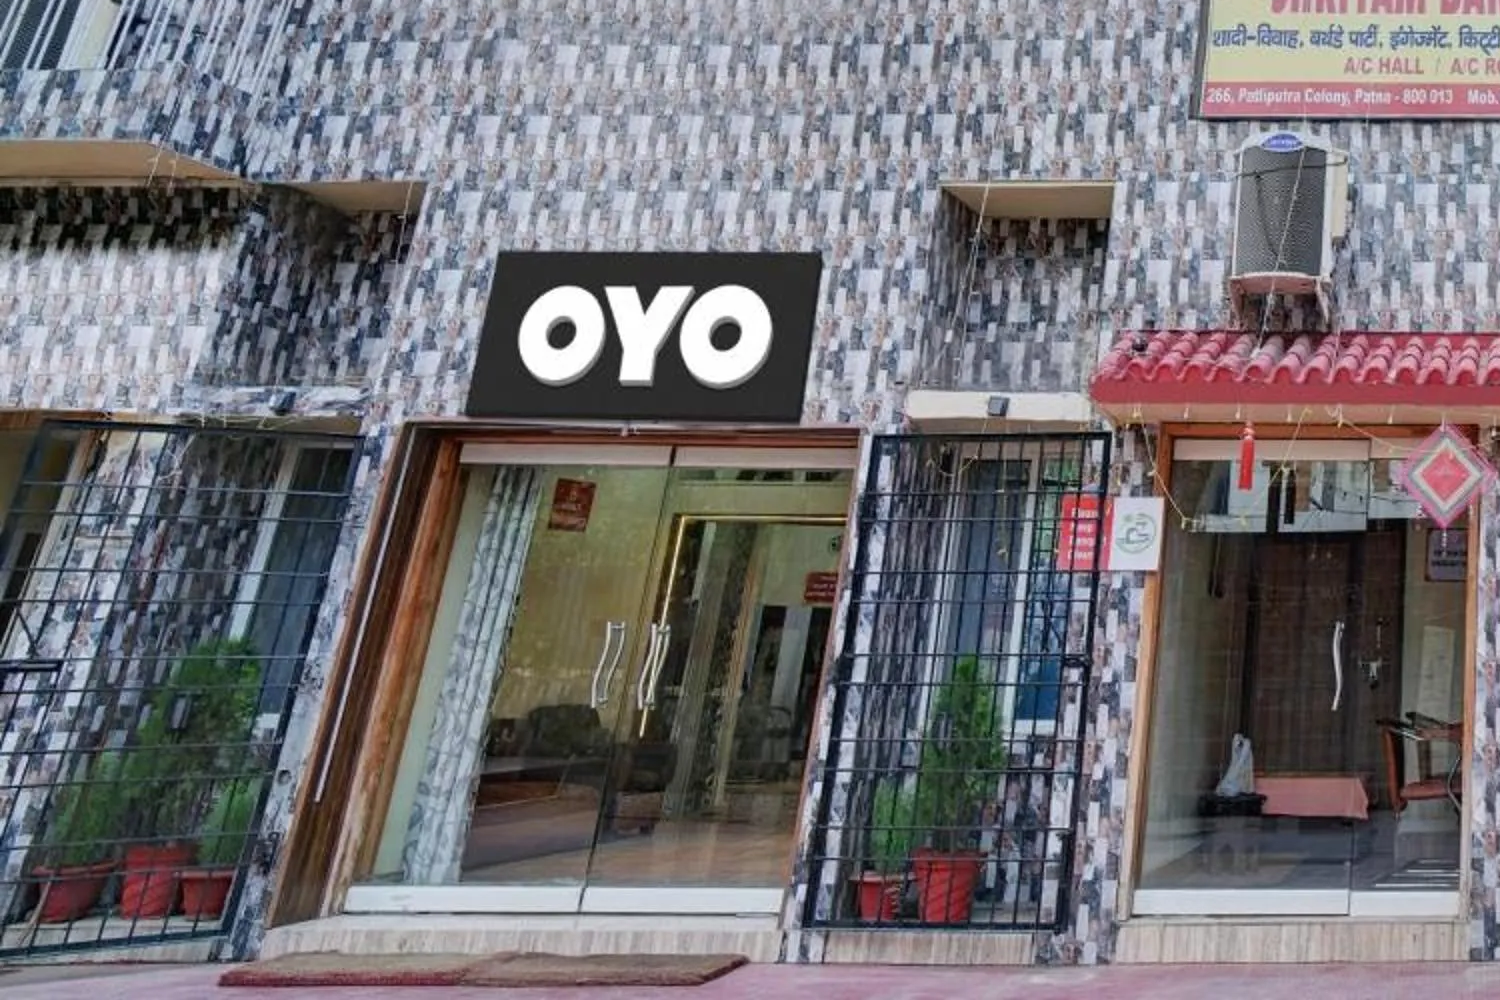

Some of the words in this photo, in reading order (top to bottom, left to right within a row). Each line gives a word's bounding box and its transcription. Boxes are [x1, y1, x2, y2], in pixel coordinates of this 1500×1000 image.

[1344, 57, 1373, 75] A/C
[1379, 57, 1425, 75] HALL
[1450, 57, 1479, 75] A/C
[1355, 87, 1392, 104] Patna
[1467, 89, 1499, 105] Mob.
[517, 284, 775, 390] OYO
